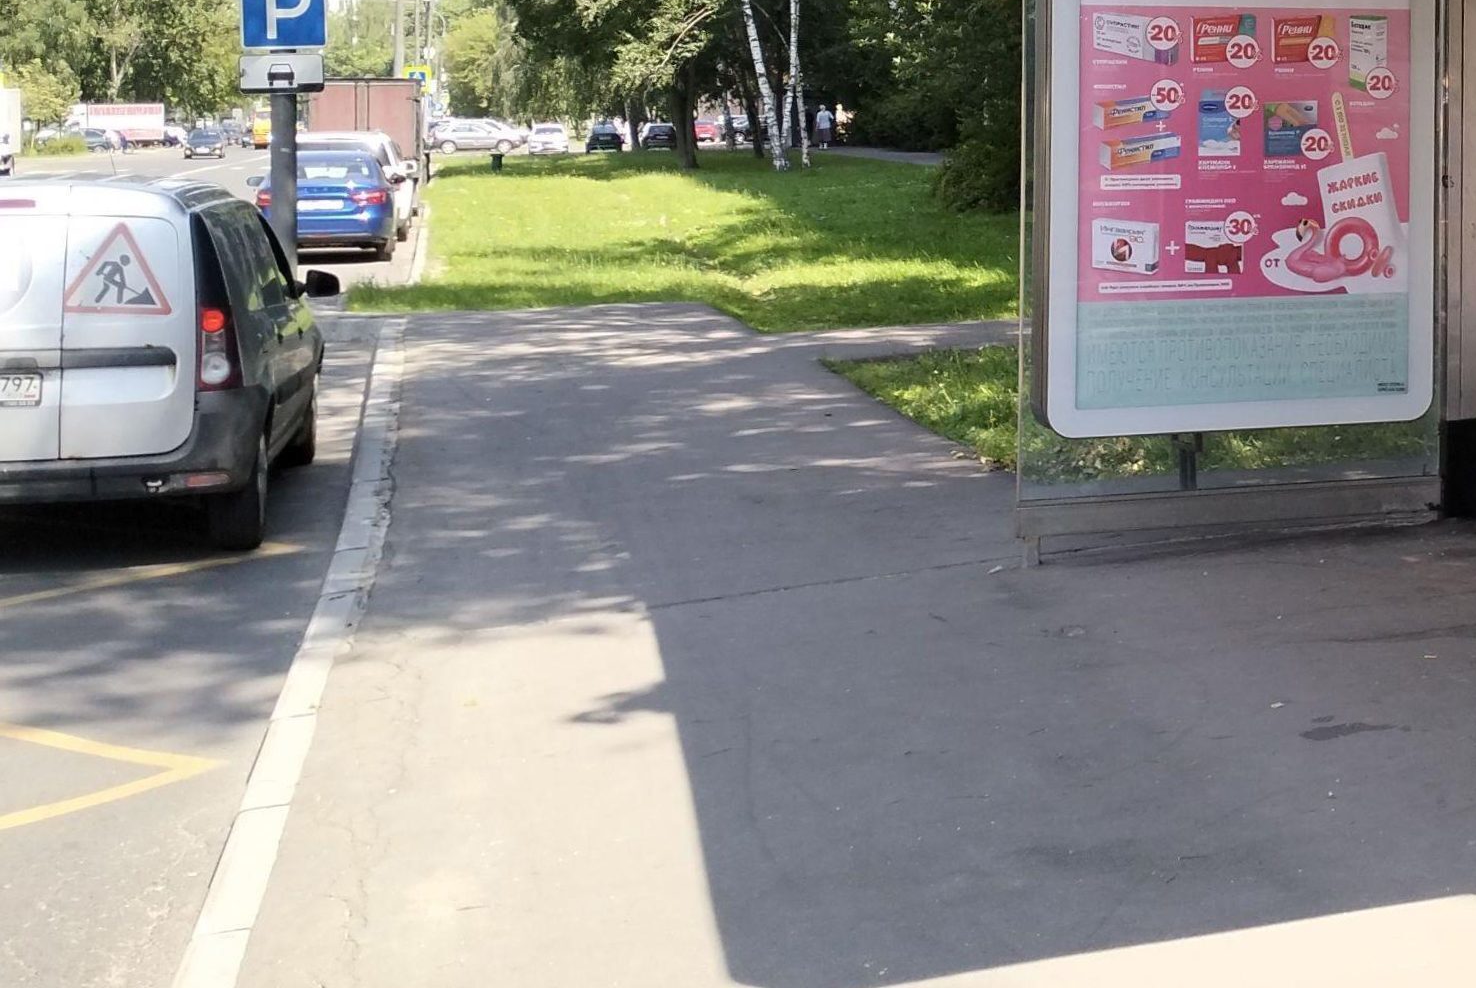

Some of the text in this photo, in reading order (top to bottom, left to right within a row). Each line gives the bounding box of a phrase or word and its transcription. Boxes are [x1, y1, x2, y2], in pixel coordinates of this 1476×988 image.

[1327, 171, 1380, 194] ЖАРКИЕ
[1332, 191, 1383, 214] СКИДКИ
[1264, 258, 1280, 268] ОТ
[0, 376, 35, 392] 797
